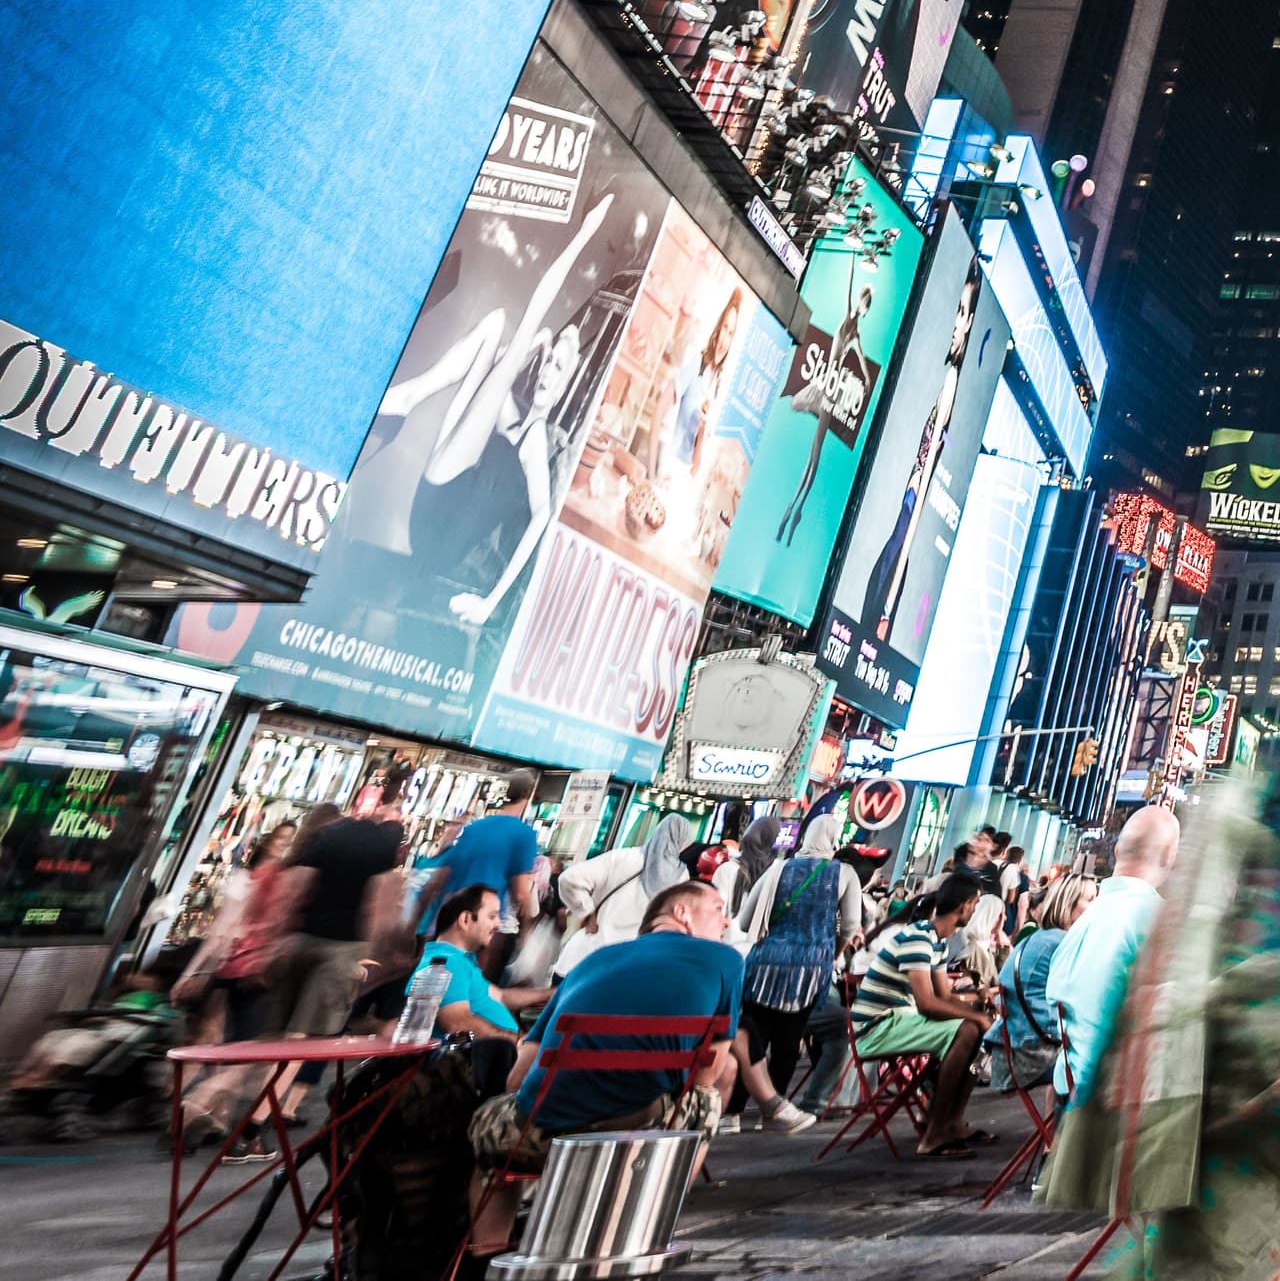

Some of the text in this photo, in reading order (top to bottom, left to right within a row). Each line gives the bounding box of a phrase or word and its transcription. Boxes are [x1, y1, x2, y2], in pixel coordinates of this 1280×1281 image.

[509, 114, 588, 172] YEARS
[0, 333, 348, 551] OUTFITTERS
[1183, 544, 1209, 575] PLAZA
[279, 619, 475, 694] CHICAGOTHEMUSICAL.COM
[510, 529, 697, 740] WAITRESS
[823, 635, 851, 668] STRUT
[243, 736, 363, 807] GRAND
[699, 749, 770, 779] Sanrio
